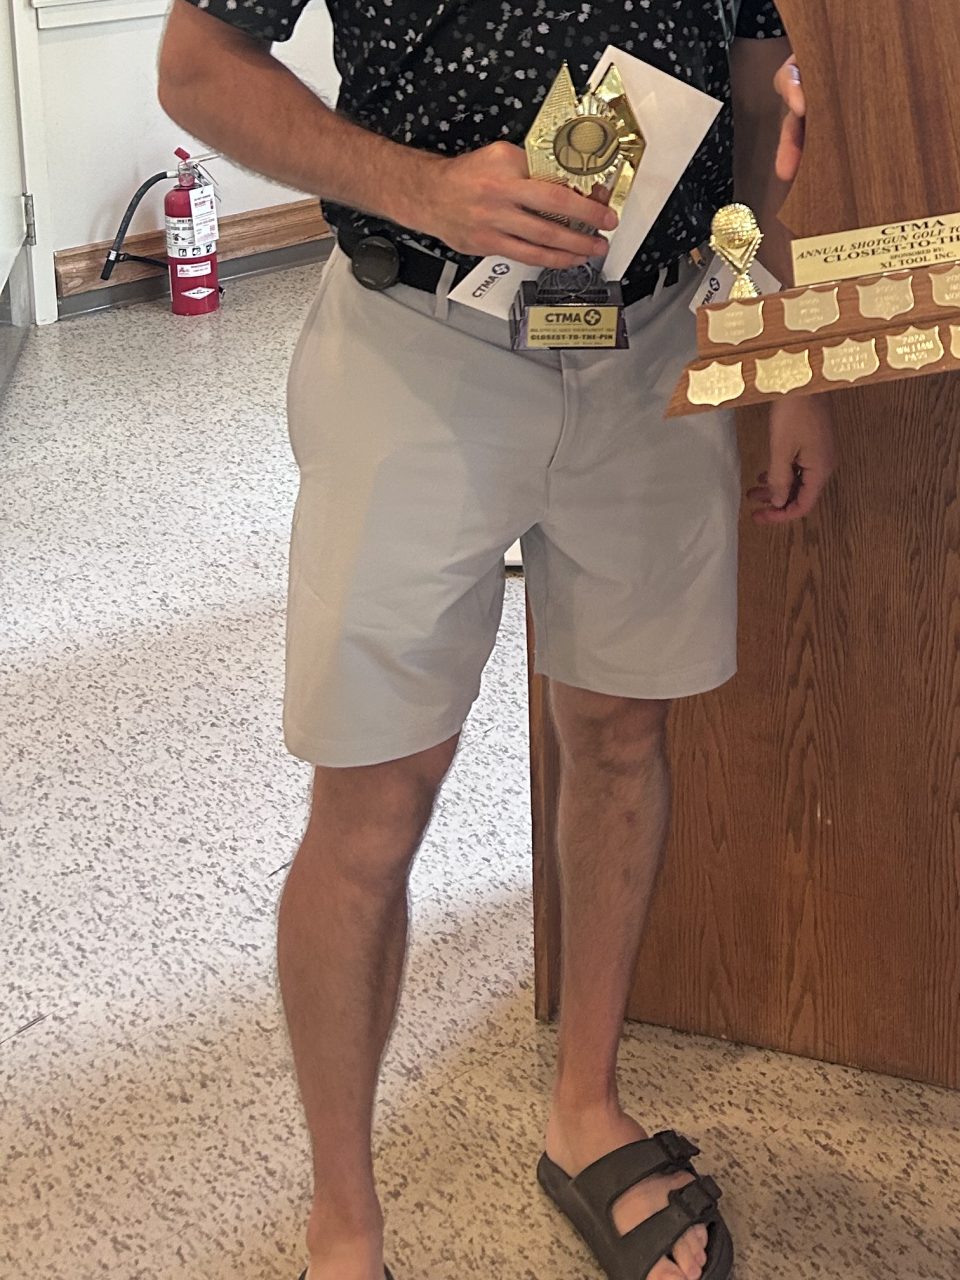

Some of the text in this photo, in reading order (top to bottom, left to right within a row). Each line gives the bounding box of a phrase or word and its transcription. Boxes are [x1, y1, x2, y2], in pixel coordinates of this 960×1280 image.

[881, 219, 945, 236] CTMA
[796, 244, 847, 260] ANNUAL
[849, 234, 909, 251] SHOTGUN
[912, 227, 946, 241] GOLF
[880, 251, 957, 269] XL TOOL INC.
[472, 275, 499, 298] CTMA
[545, 312, 582, 324] CTMA
